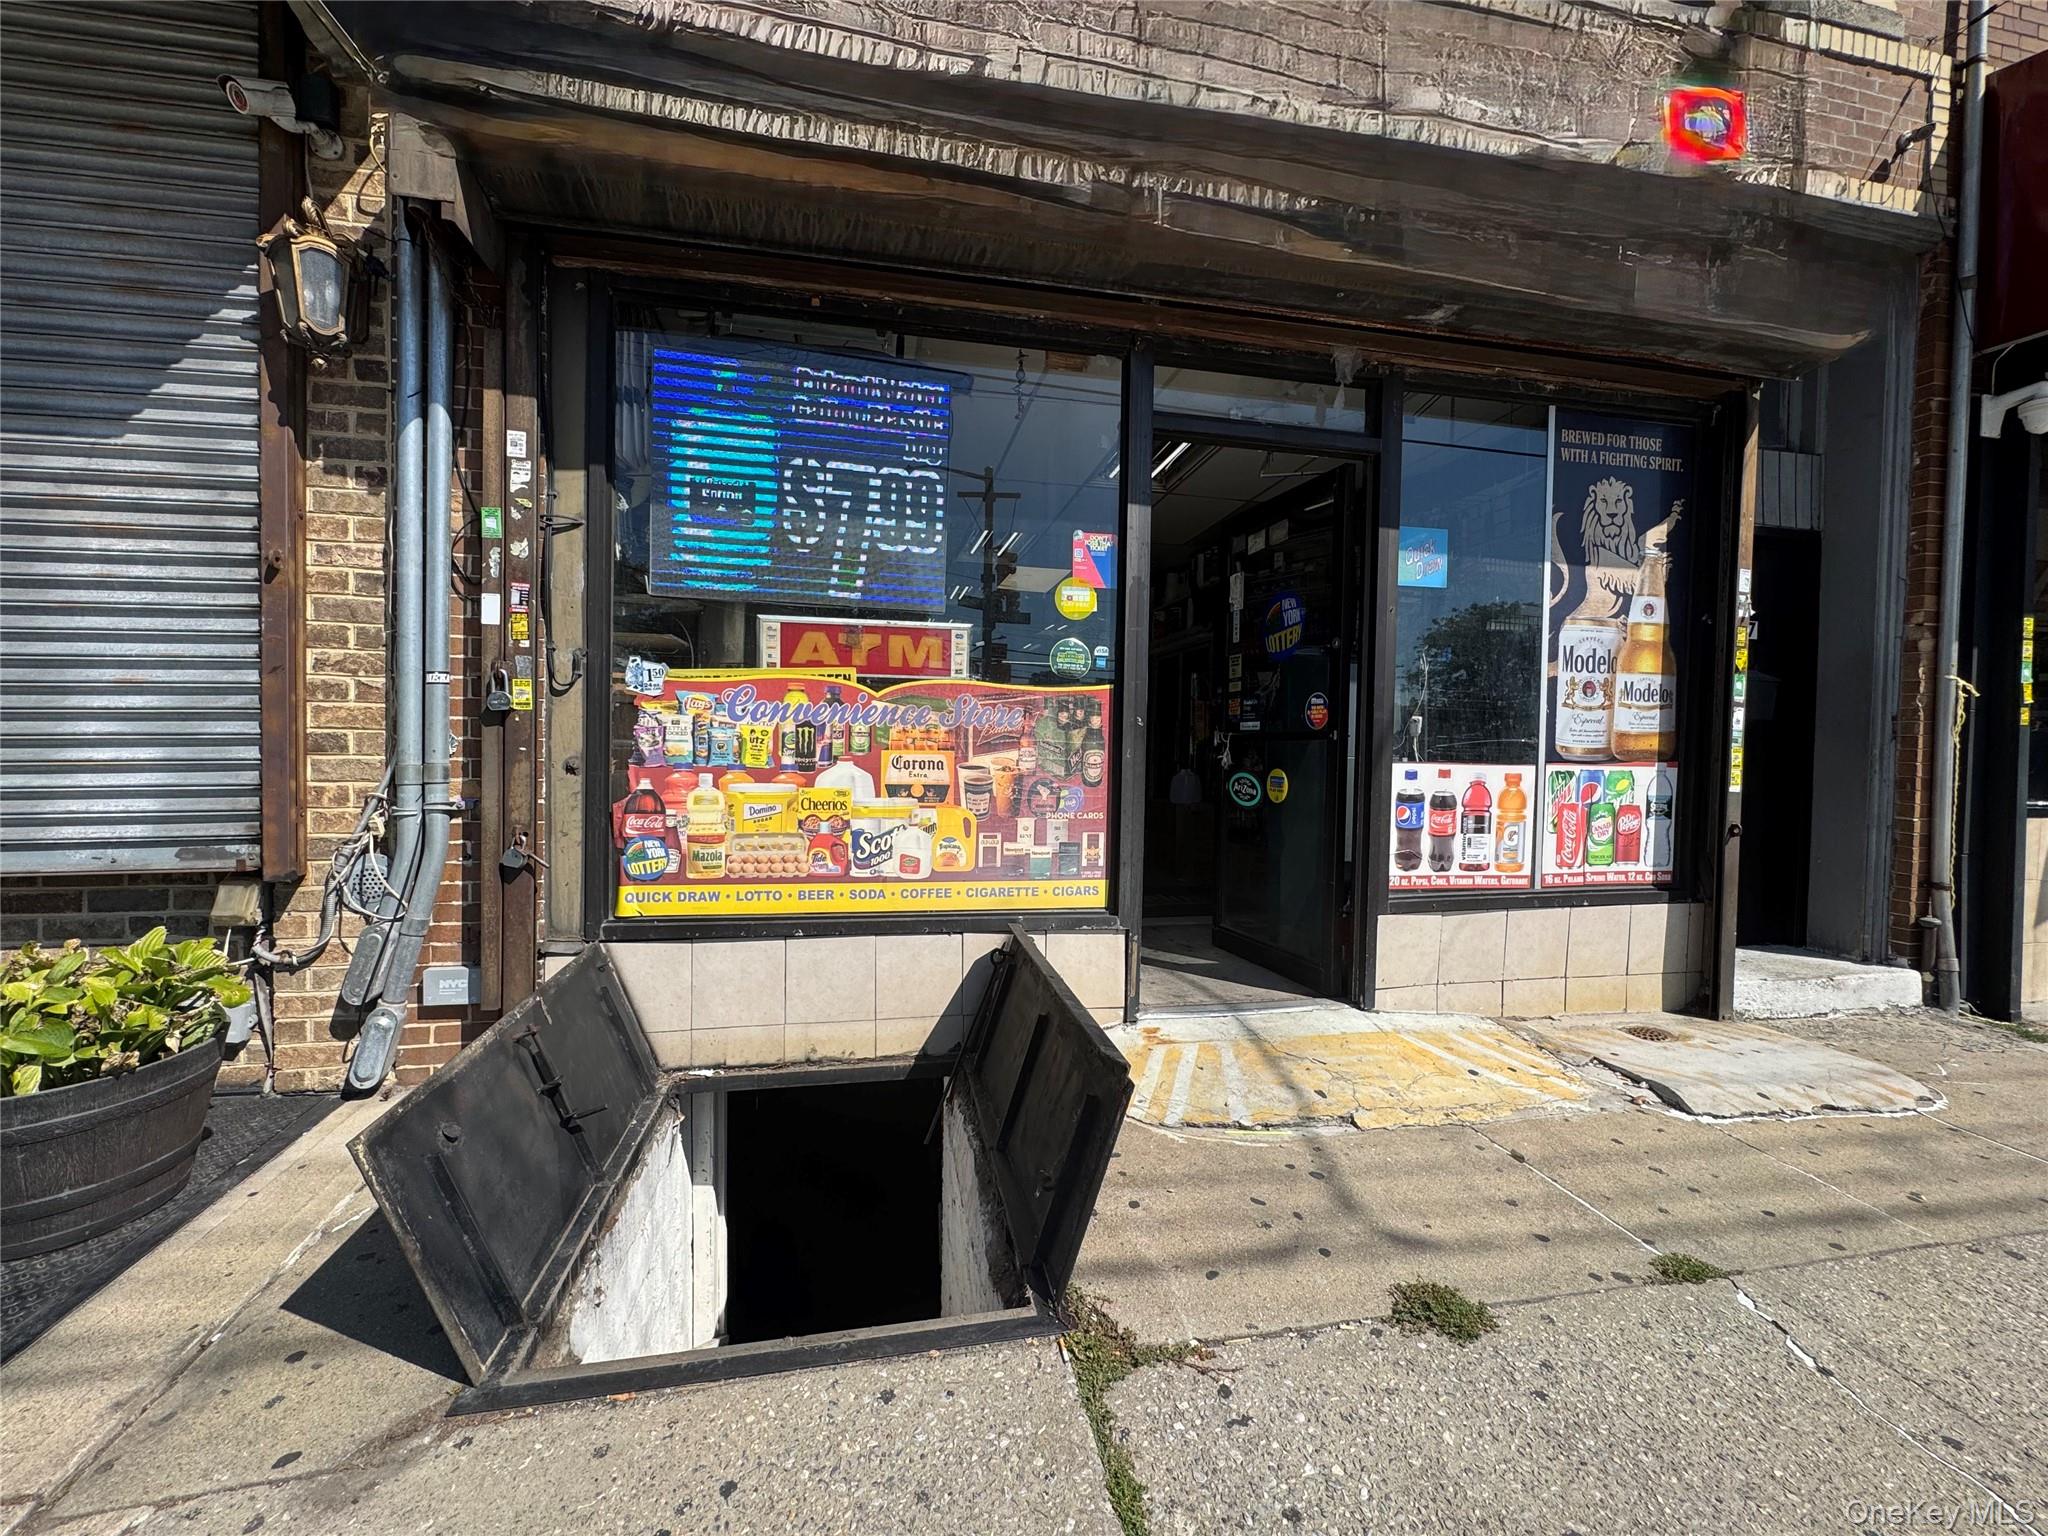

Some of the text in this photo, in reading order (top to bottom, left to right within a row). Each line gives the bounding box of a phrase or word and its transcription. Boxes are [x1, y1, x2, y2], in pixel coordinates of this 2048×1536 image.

[1561, 429, 1662, 452] BREWED FOR THOSE
[1560, 448, 1684, 473] WITH A FIGHTING SPIRIT.
[1405, 541, 1436, 566] Quick
[1416, 559, 1442, 580] Draw
[1281, 597, 1297, 609] NEW
[1265, 623, 1302, 653] LOTTERY
[789, 631, 944, 670] ATM
[1562, 644, 1617, 675] Modelo
[1624, 681, 1668, 703] Modelo
[722, 684, 1025, 730] Convenience Store
[891, 755, 945, 773] Corona
[749, 804, 777, 816] Domino
[801, 798, 848, 811] Cheerios
[644, 839, 660, 848] NEW
[692, 850, 722, 862] Mazola
[812, 853, 826, 864] Tide
[870, 851, 890, 866] 1000
[1389, 877, 1400, 886] 20
[624, 886, 1099, 903] QUICK DRAW LOTTO BEER SODA COFFEE CIGARETTE CIGARS
[440, 980, 467, 988] NYC
